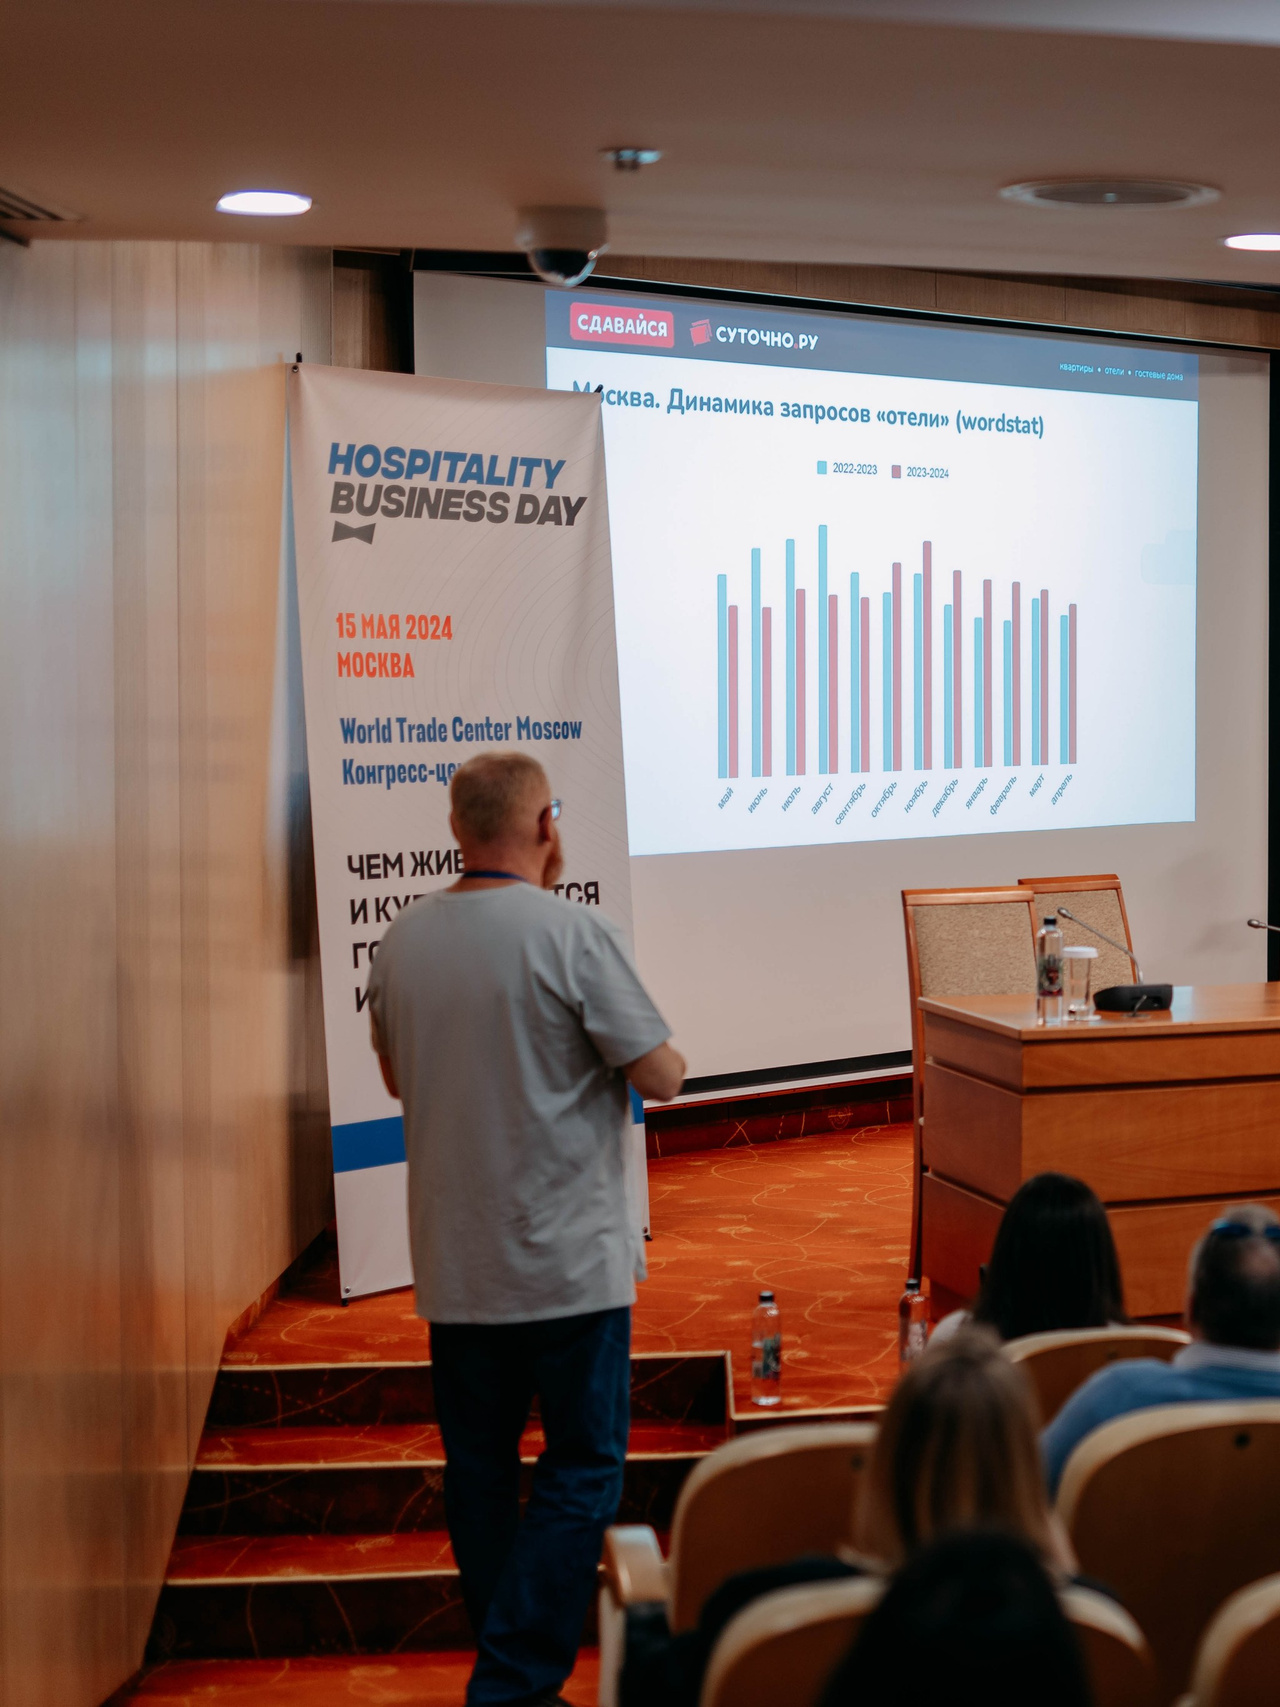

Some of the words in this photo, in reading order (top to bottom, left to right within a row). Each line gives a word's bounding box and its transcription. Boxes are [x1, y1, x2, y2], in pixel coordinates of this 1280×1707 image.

[577, 313, 668, 338] СДАВАЙСЯ
[716, 326, 818, 350] СУТОЧНО.РУ
[1059, 363, 1094, 373] квартиры
[1105, 367, 1124, 376] отели
[1135, 369, 1165, 379] гостевые
[1166, 373, 1183, 381] дома
[573, 380, 660, 409] Мсква.
[666, 388, 774, 416] Динамика
[780, 401, 871, 424] запросов
[876, 409, 949, 428] «отели»
[956, 410, 1044, 439] (wordstat)
[327, 442, 566, 489] HOSPITALITY
[833, 462, 878, 476] 2022-2023
[907, 466, 949, 479] 2023-2024
[330, 481, 512, 524] BUSINESS
[514, 493, 588, 526] DAY
[336, 613, 356, 639] 15
[361, 613, 401, 640] МАЯ
[406, 615, 453, 641] 2024
[337, 651, 415, 678] МОСКВА
[340, 717, 392, 744] World
[396, 717, 447, 743] Trade
[452, 716, 512, 742] Center
[516, 715, 582, 740] Moscow
[342, 758, 461, 790] Конгресс-це
[1029, 773, 1045, 797] март
[1050, 773, 1073, 805] апрель
[718, 787, 734, 810] май
[747, 787, 768, 814] июнь
[781, 786, 801, 812] июль
[811, 783, 834, 815] август
[835, 783, 866, 825] сентябрь
[871, 781, 898, 818] октябрь
[904, 780, 928, 813] ноябрь
[931, 779, 959, 818] декабрь
[965, 777, 988, 810] январь
[989, 775, 1017, 816] февраль
[347, 851, 404, 880] ЧЕМ
[350, 899, 368, 925] И
